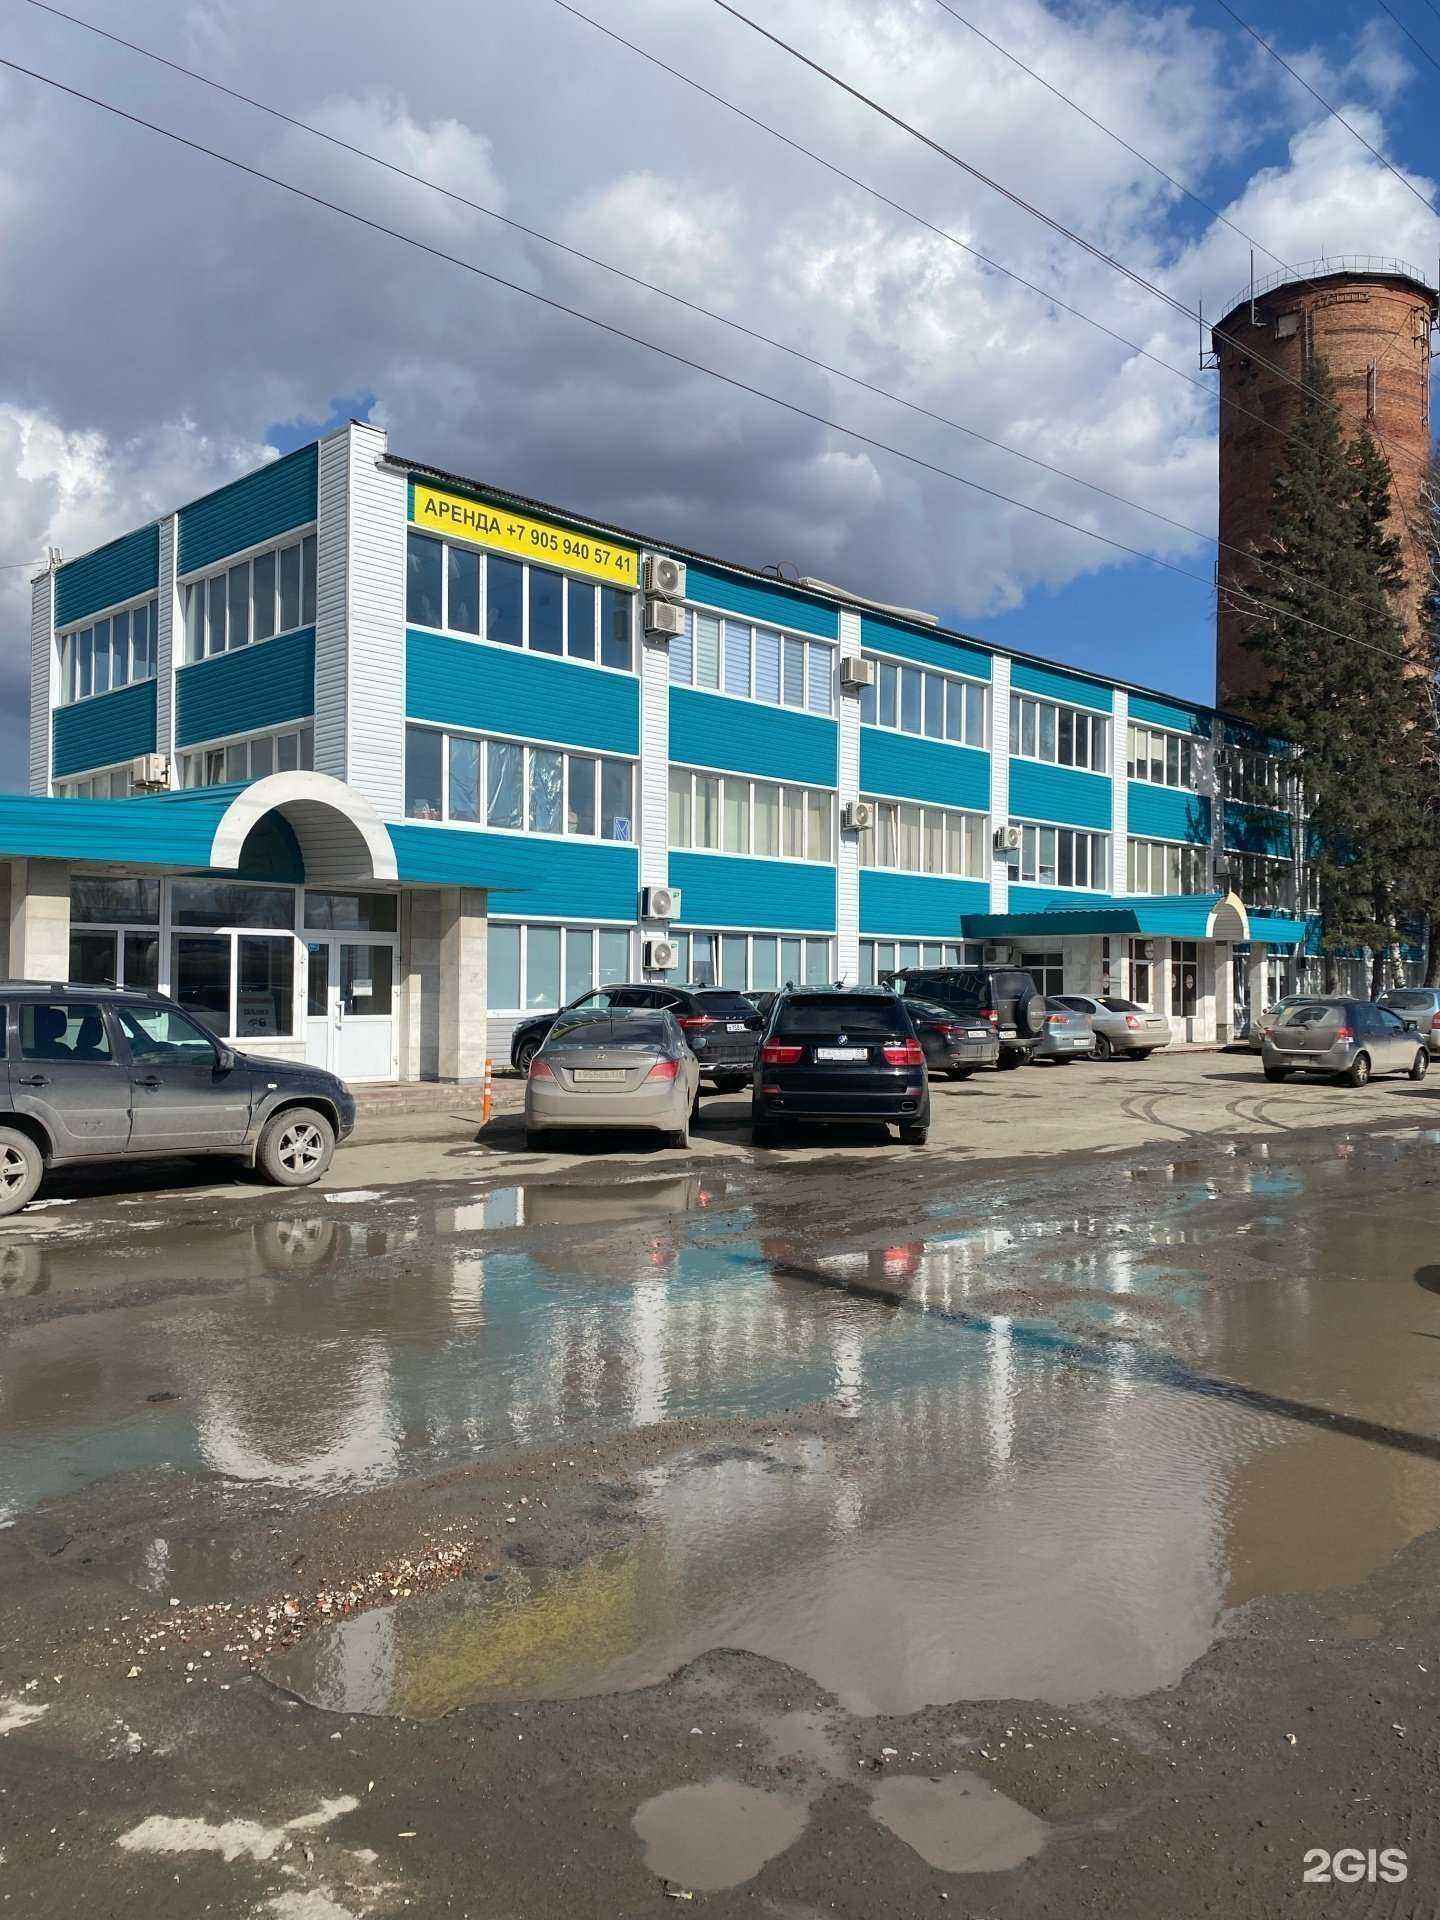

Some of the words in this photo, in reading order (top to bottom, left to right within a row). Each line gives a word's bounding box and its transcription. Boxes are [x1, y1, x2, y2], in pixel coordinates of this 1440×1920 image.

[424, 498, 501, 535] АРЕНДА
[506, 524, 525, 541] +7
[531, 529, 558, 551] 905
[563, 539, 589, 560] 940
[594, 548, 611, 566] 57
[615, 555, 631, 573] 41
